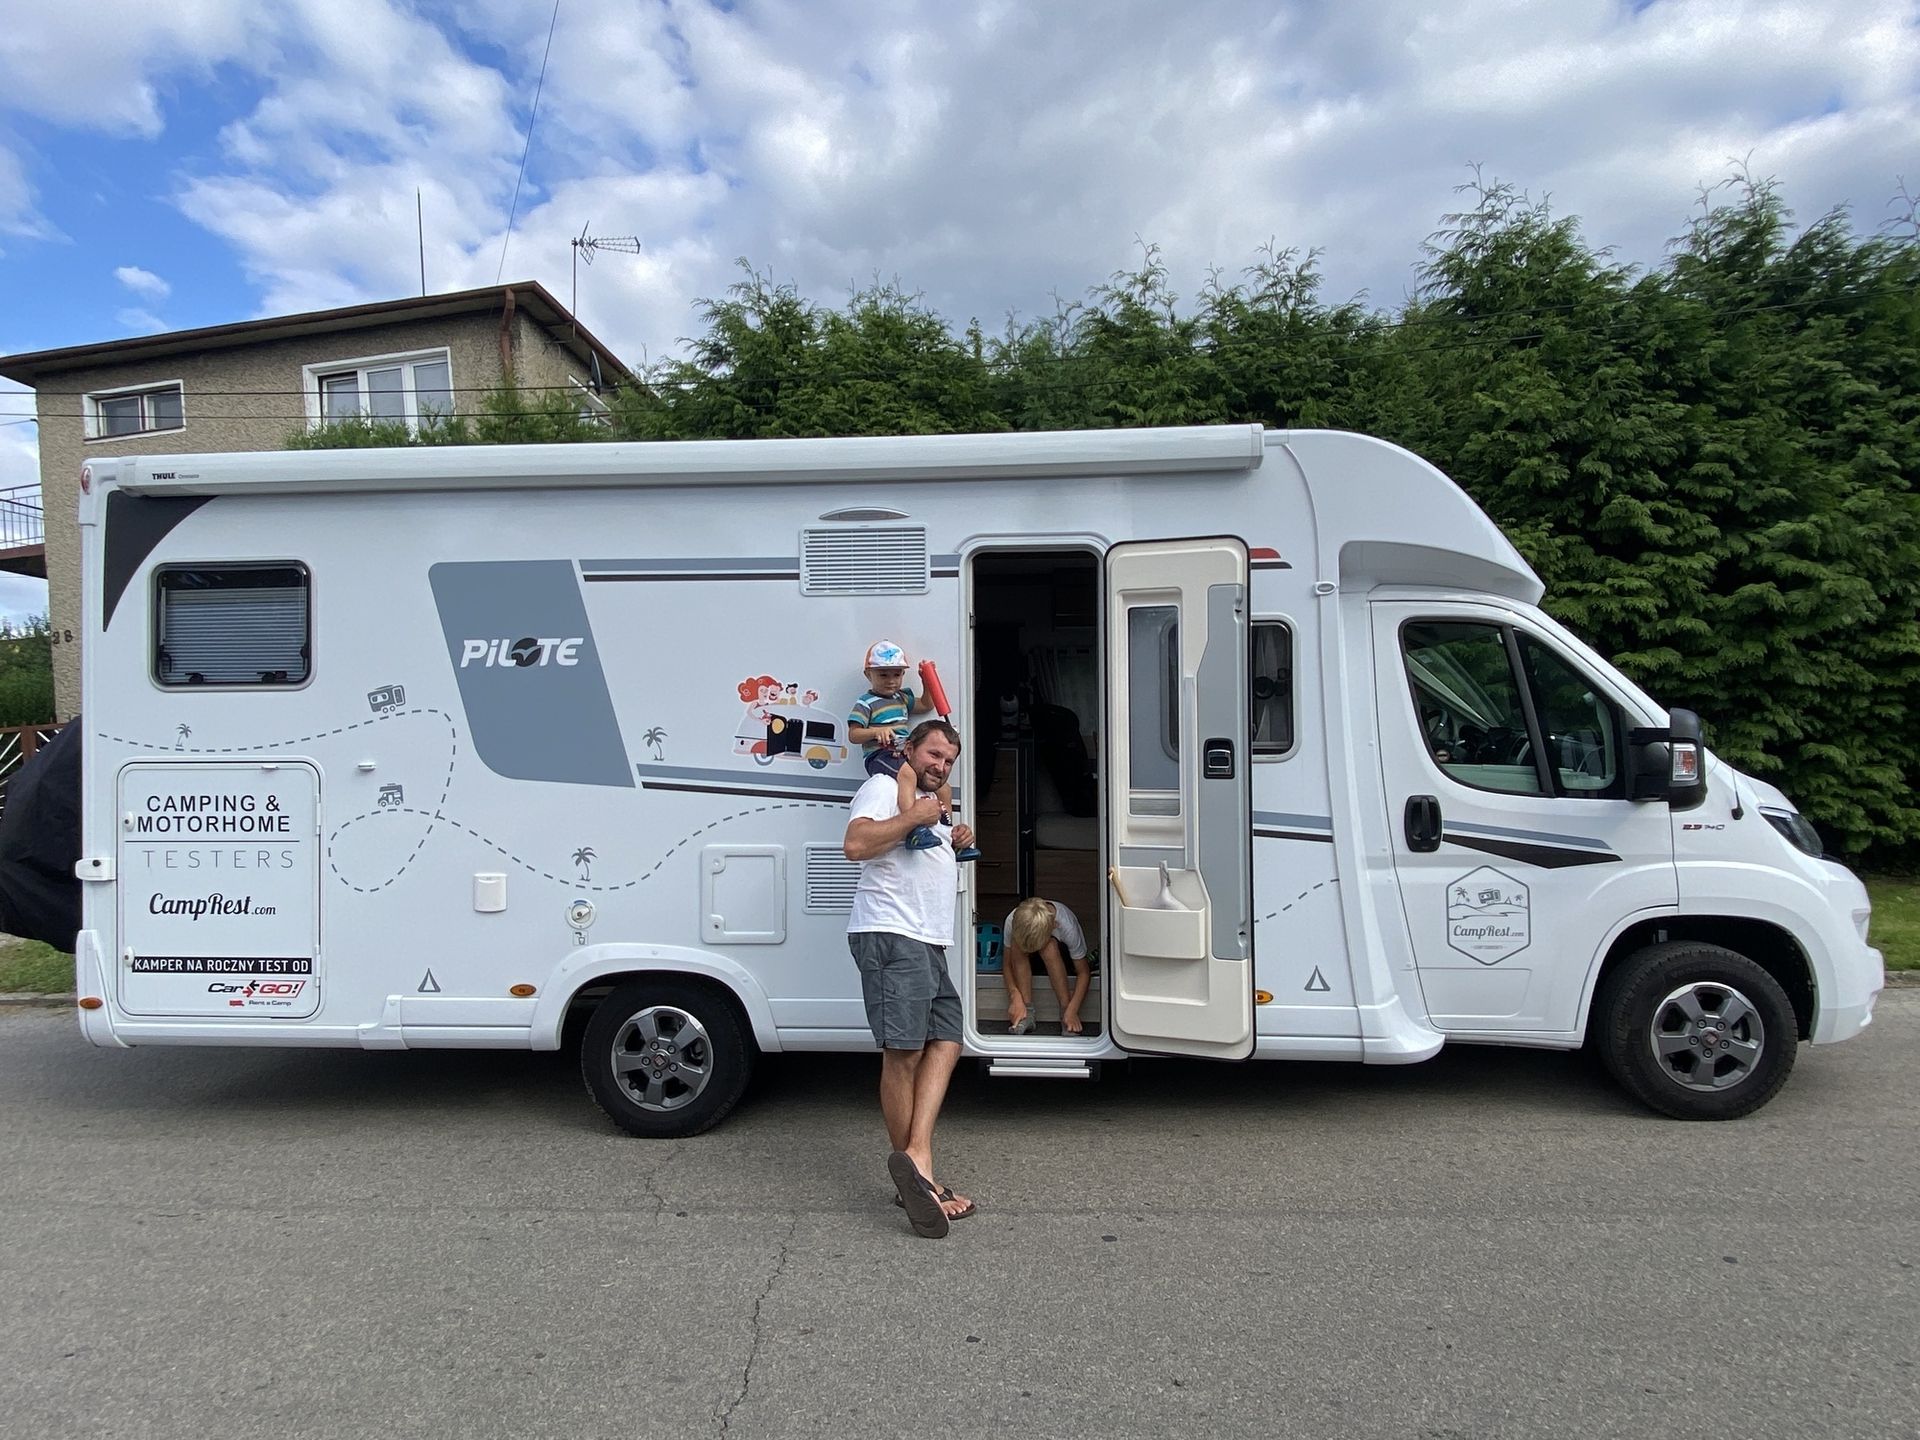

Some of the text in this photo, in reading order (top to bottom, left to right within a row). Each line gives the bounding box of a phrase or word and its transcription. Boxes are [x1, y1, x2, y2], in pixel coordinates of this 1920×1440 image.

[152, 472, 176, 480] THULE
[147, 795, 281, 812] CAMPING &
[137, 815, 291, 833] MOTORHOME
[142, 850, 294, 868] TESTERS
[149, 892, 277, 921] CampRest.com
[134, 959, 309, 973] KAMPER NA ROCZNY TEST OD
